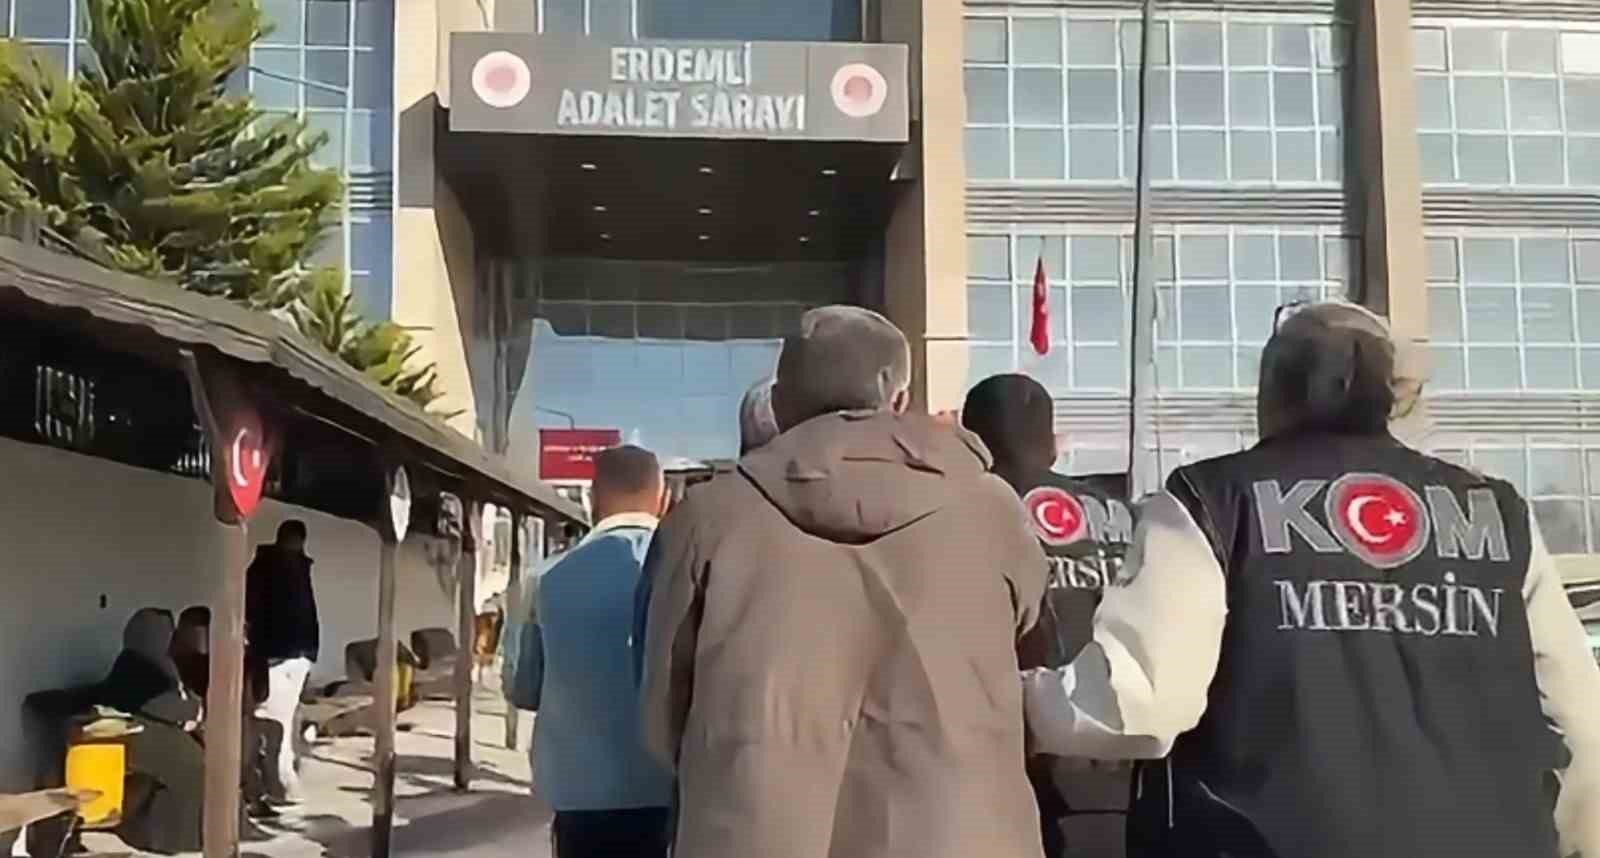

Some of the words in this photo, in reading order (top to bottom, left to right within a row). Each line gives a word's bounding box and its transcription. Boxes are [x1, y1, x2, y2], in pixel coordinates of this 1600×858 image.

[611, 41, 752, 87] ERDEMLİ
[557, 88, 681, 128] ADALET
[690, 92, 806, 130] SARAYI
[1023, 485, 1133, 546] OM
[1252, 472, 1510, 569] KOM
[1273, 571, 1504, 637] MERSİN
